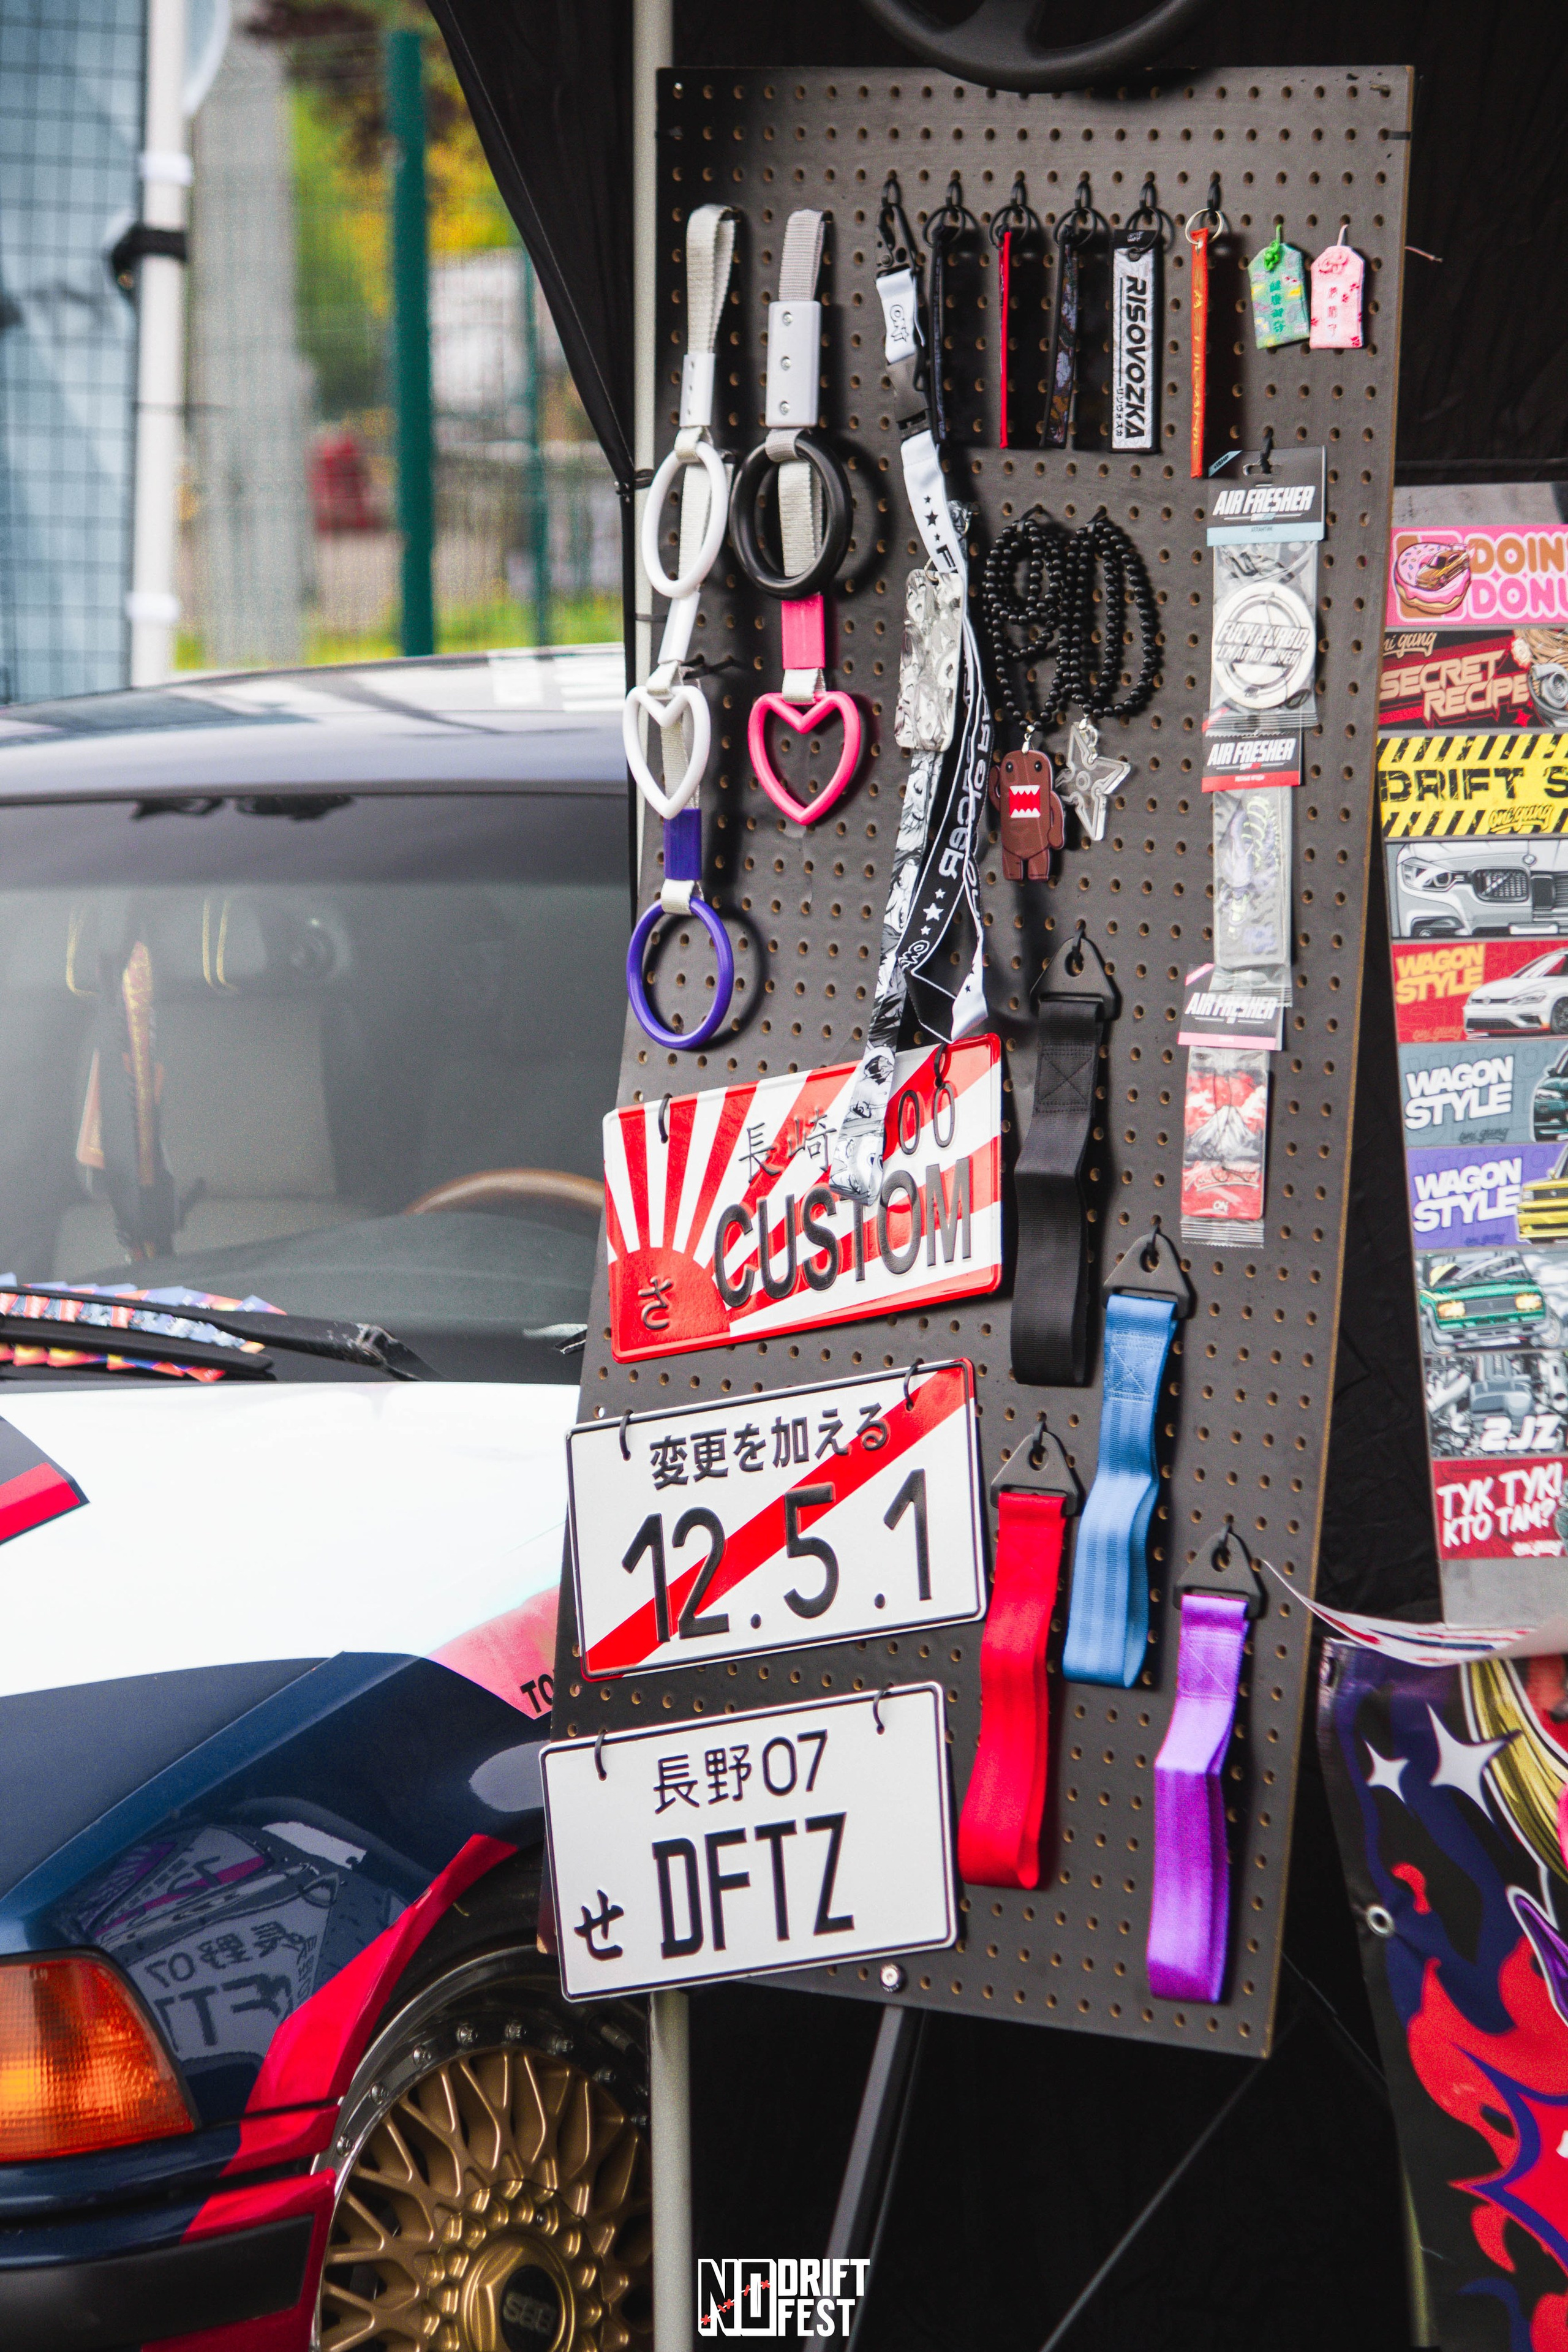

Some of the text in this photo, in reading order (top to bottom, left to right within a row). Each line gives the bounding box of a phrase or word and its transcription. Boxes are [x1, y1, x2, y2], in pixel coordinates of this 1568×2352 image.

[1125, 275, 1147, 439] RISOVOZKA
[1212, 485, 1316, 516] AIR FRESHER
[1471, 537, 1568, 573] DOIN
[1397, 631, 1437, 659] gang
[1379, 650, 1506, 701] SECRET
[1423, 674, 1530, 722] RECIPE
[1207, 737, 1297, 766] AIR FRESHER
[1380, 767, 1525, 802] DRIFT
[1395, 943, 1485, 979] WAGON
[1185, 992, 1216, 1016] AIR
[1396, 966, 1483, 1005] STYLE
[1406, 1055, 1514, 1098] WAGON
[1404, 1082, 1513, 1129] STYLE
[738, 1109, 837, 1183] 長崎
[1414, 1158, 1522, 1202] WAGON
[1413, 1184, 1520, 1233] STYLE
[713, 1158, 972, 1308] CUSTOM
[649, 1402, 888, 1491] 変更を加える
[1480, 1413, 1562, 1452] 2JZ
[1436, 1477, 1494, 1520] TYK
[1443, 1512, 1493, 1548] KTO
[651, 1811, 856, 1959] DFTZ
[574, 1889, 624, 1962] せ
